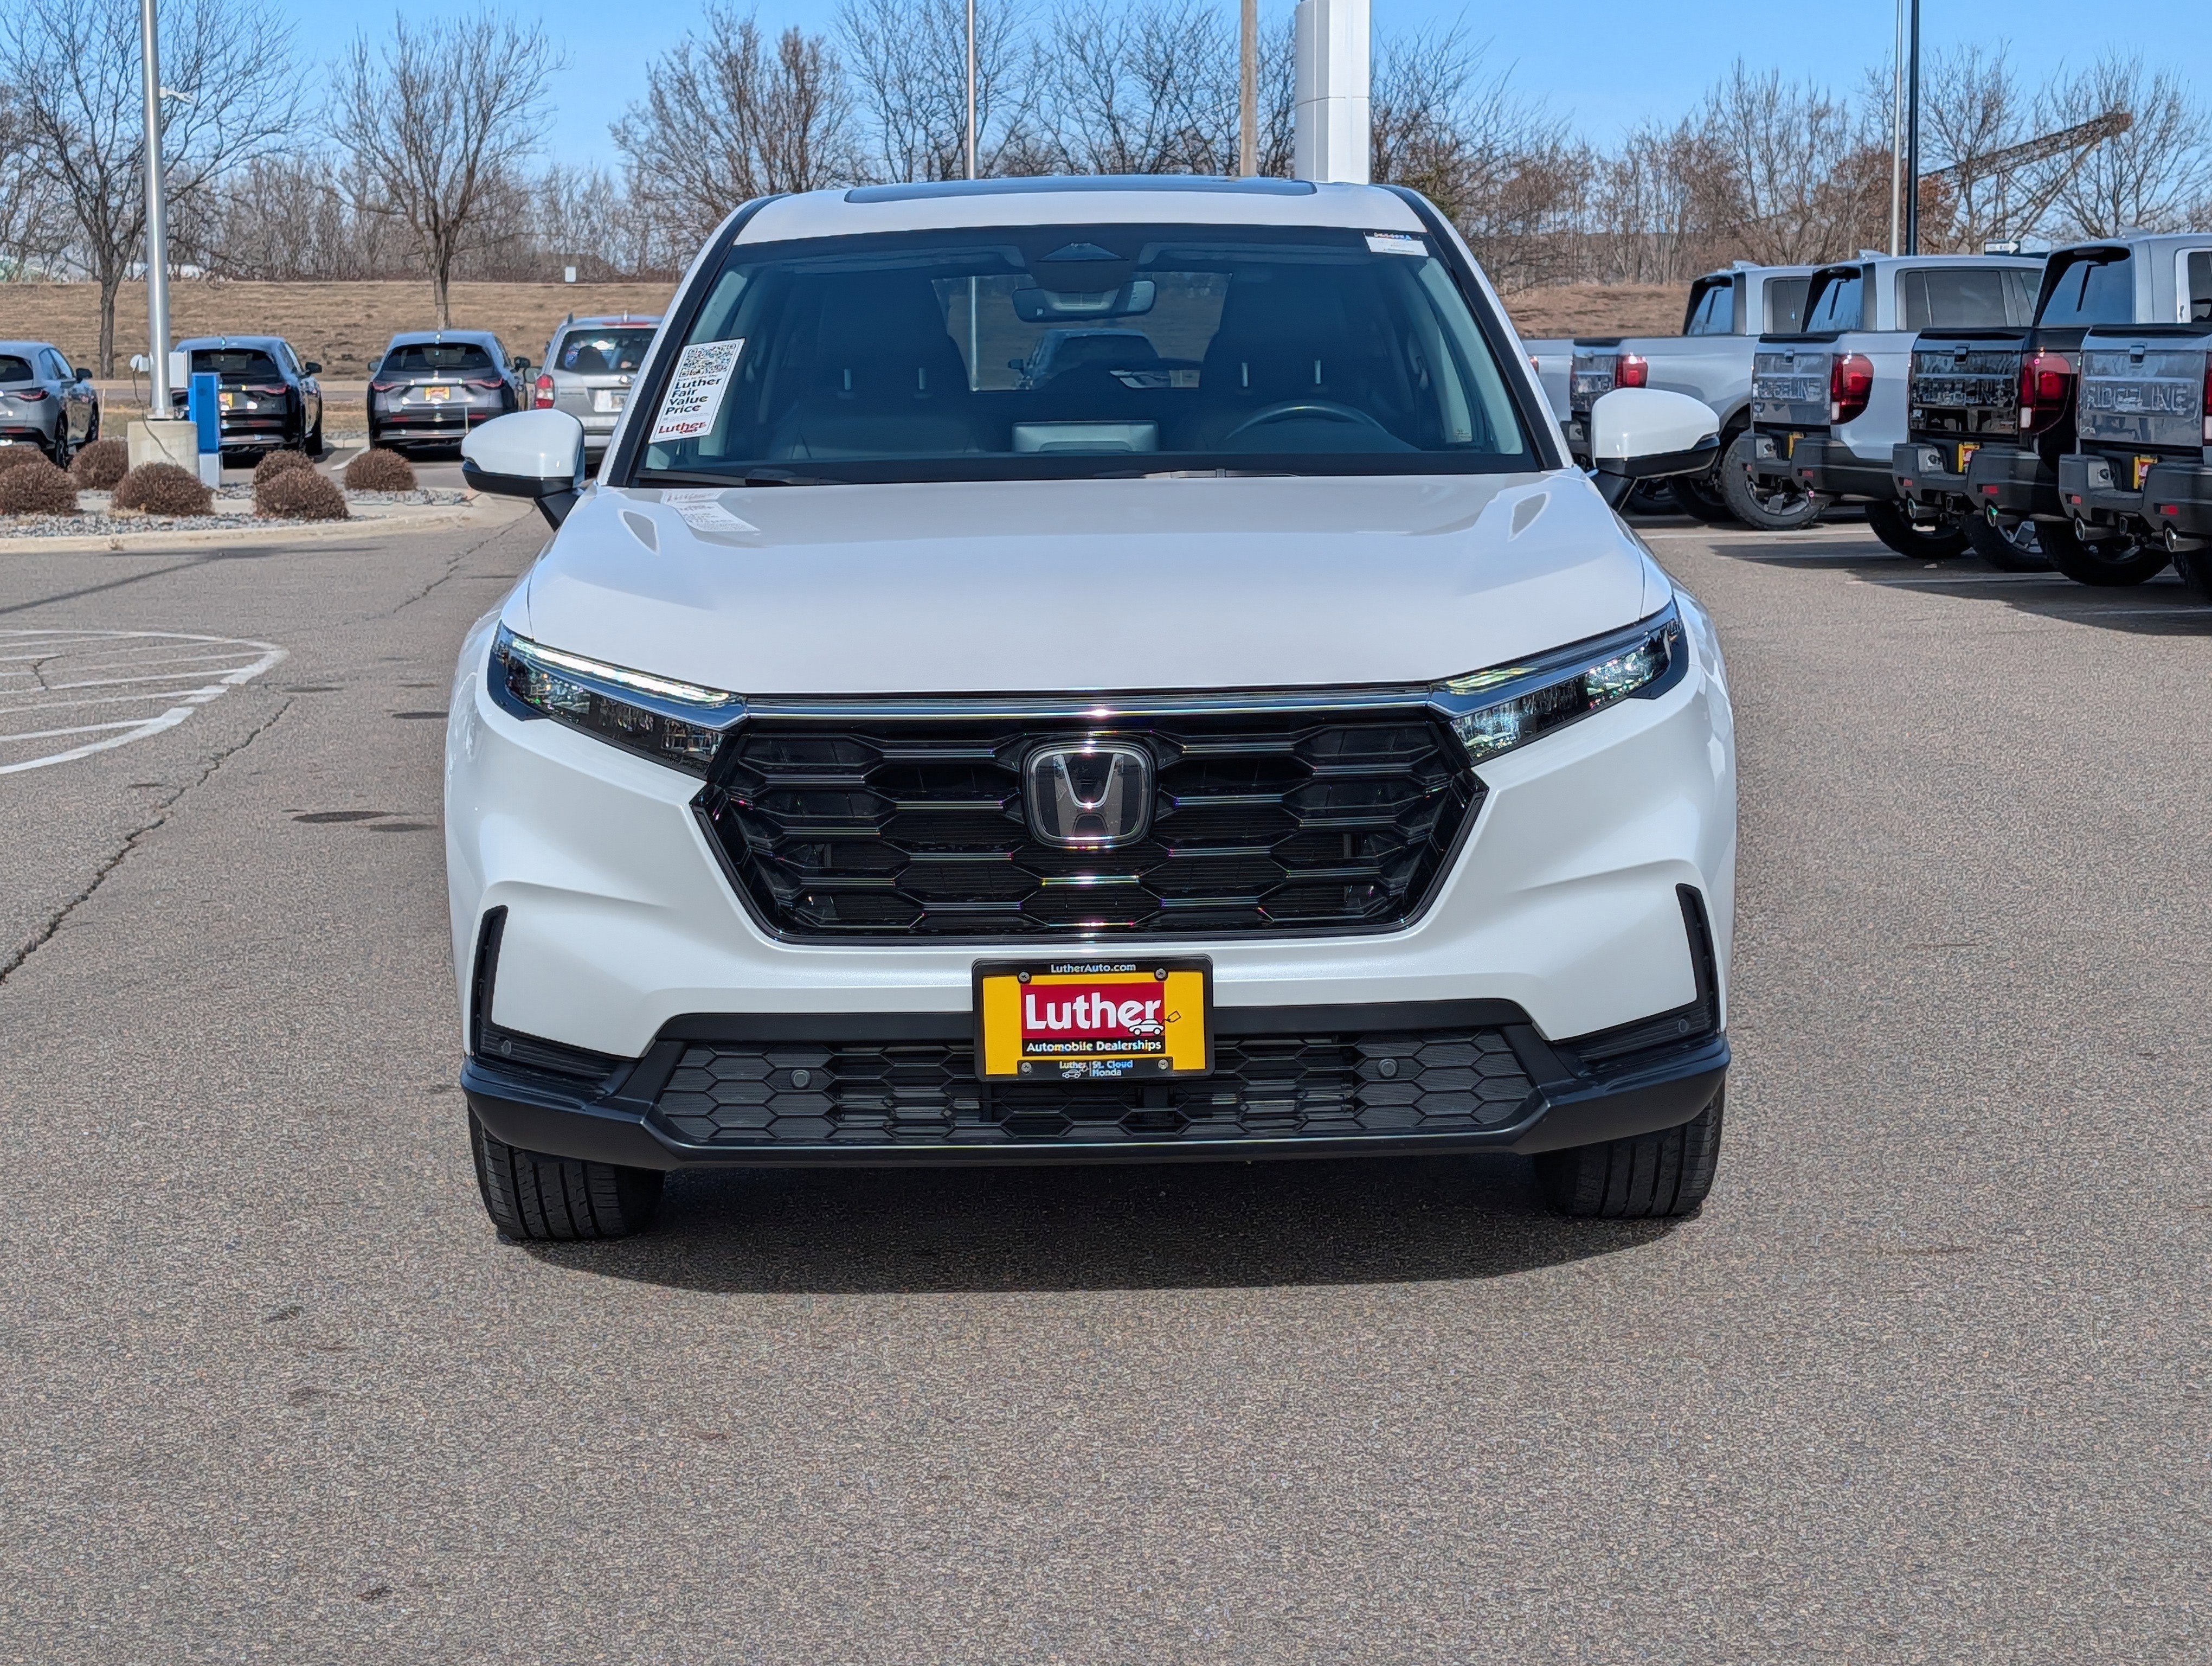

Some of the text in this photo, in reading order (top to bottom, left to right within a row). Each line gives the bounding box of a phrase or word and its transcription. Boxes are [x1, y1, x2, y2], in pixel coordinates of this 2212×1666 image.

[675, 378, 722, 389] Luther
[672, 388, 698, 398] Fair
[670, 396, 709, 406] Value
[665, 405, 701, 415] Price
[659, 421, 706, 434] Luther
[1051, 963, 1136, 973] LutherAuto.com
[1025, 992, 1161, 1030] Luther
[1026, 1040, 1162, 1052] Automobile Dealerships
[1059, 1061, 1087, 1069] Luther
[1107, 1060, 1134, 1068] Cloud
[1092, 1068, 1122, 1077] Honda
